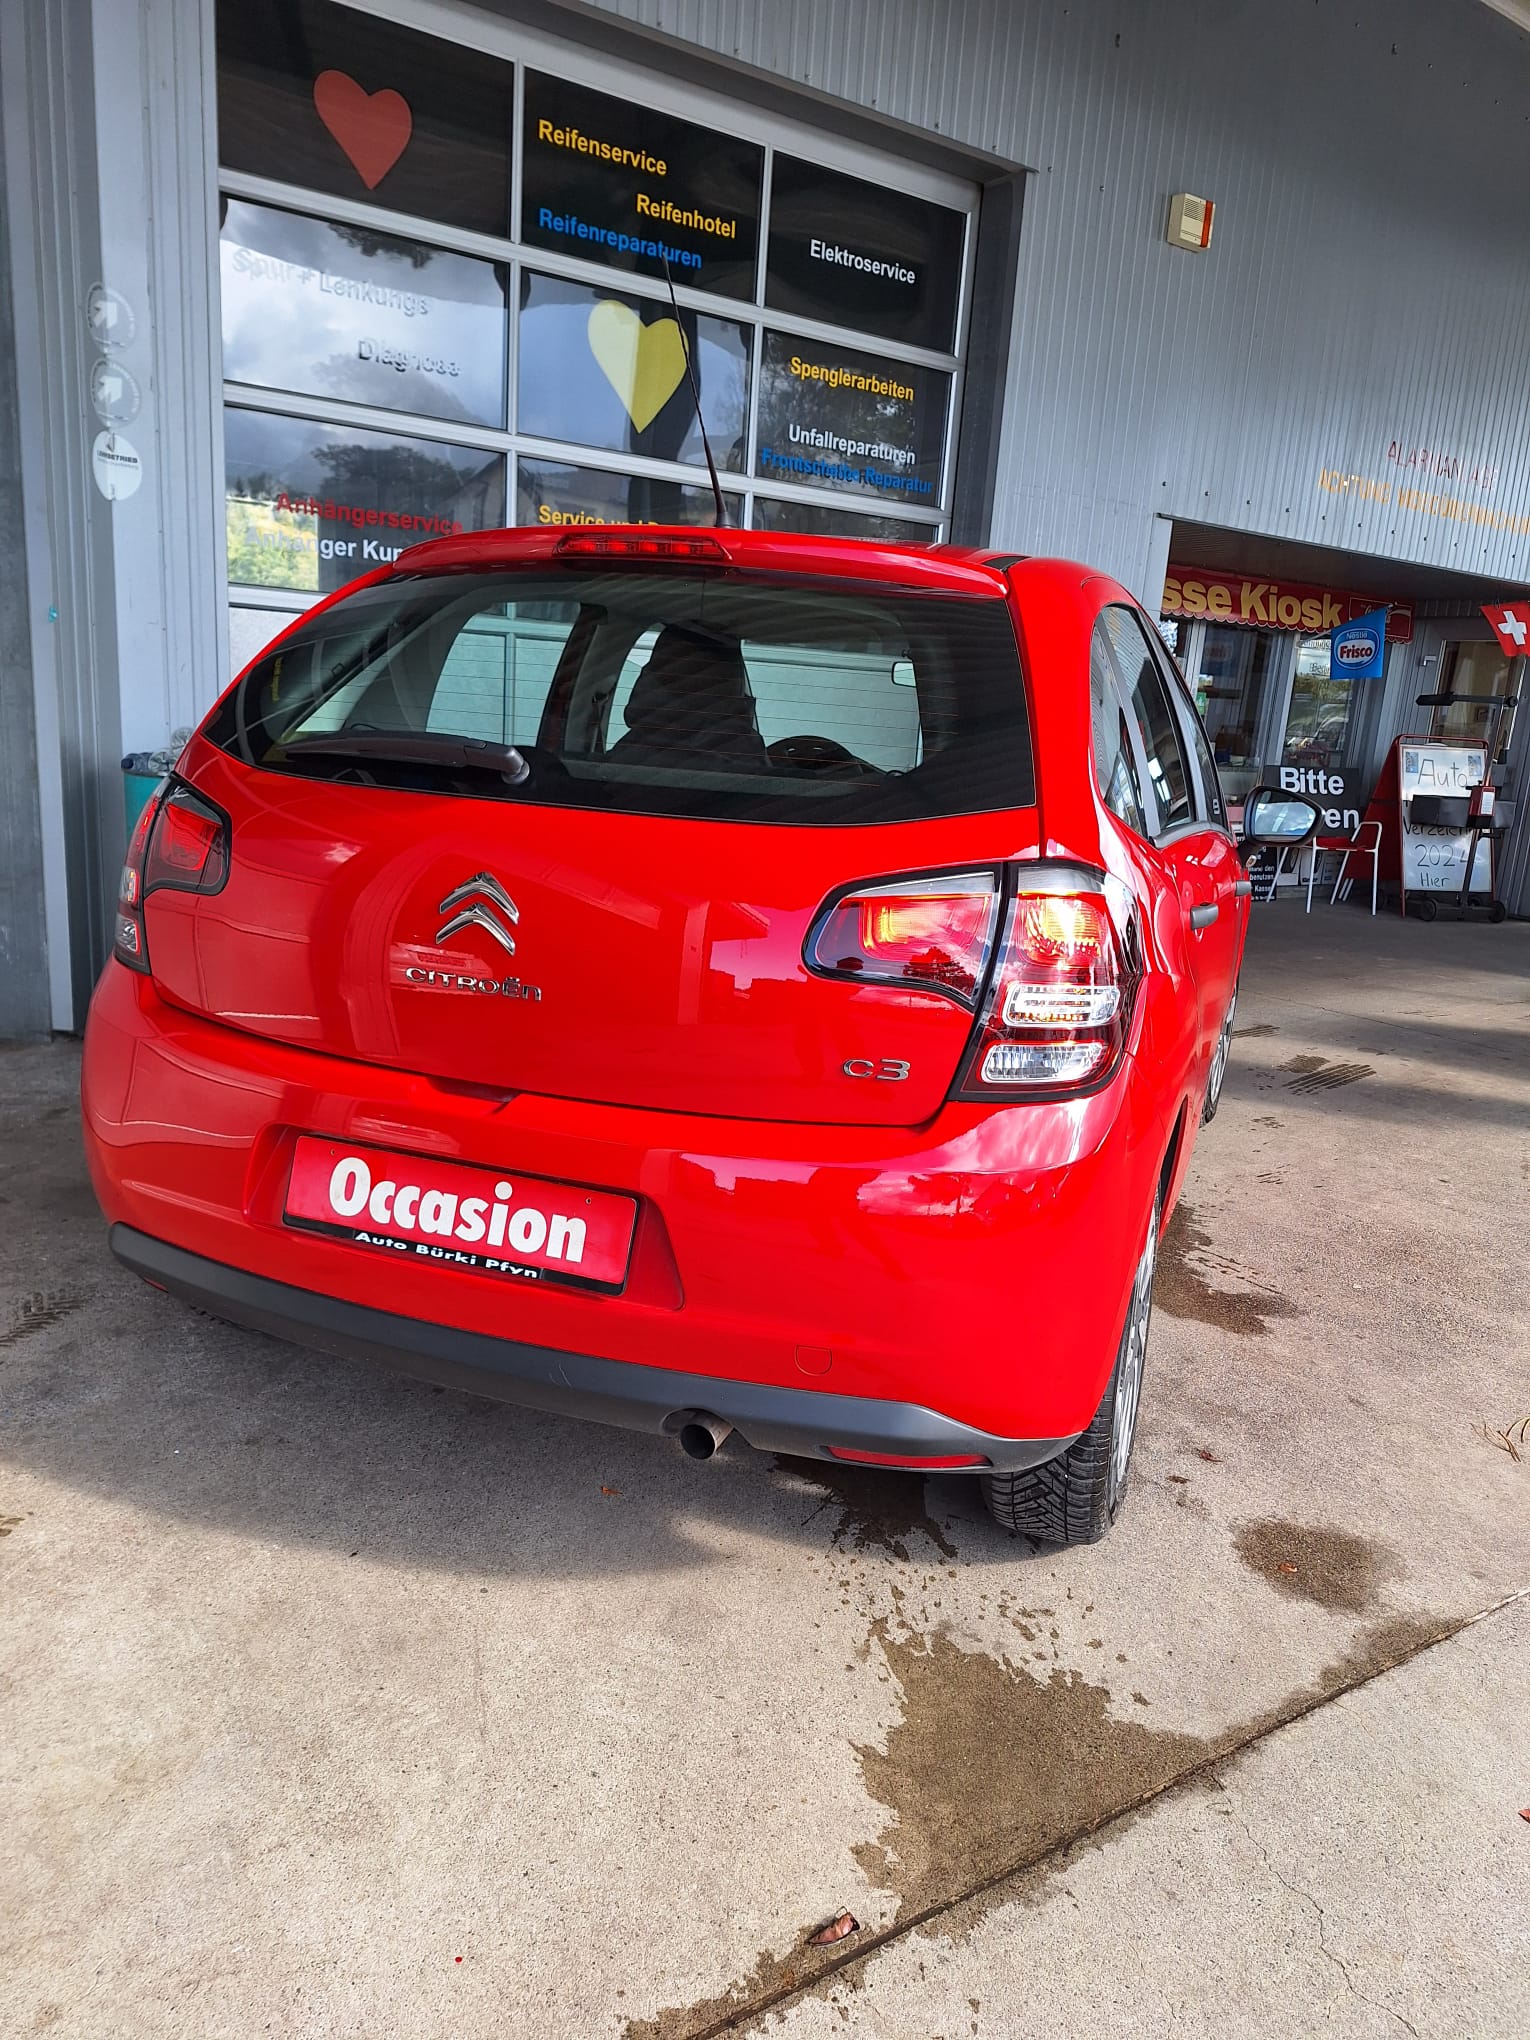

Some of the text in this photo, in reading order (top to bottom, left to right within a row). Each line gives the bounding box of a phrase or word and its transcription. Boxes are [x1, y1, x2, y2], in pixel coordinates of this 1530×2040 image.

[538, 119, 667, 176] Reifenservice
[636, 193, 736, 239] Reifenhotel
[539, 208, 702, 269] Reifenreparaturen
[232, 247, 292, 281] Spur
[319, 271, 429, 317] Lenkungs
[810, 238, 916, 284] Elektroservice
[790, 356, 915, 400] Spenglerarbeiten
[789, 423, 916, 465] Unfallreparaturen
[1318, 467, 1391, 505] ACHTUNG
[276, 492, 464, 535] Anhängerservice
[1162, 578, 1232, 617] sse
[1241, 582, 1344, 629] Kiosk
[1340, 645, 1373, 659] Frisco
[1280, 767, 1345, 795] Bitte
[1417, 758, 1468, 788] Auto
[1324, 807, 1360, 829] en
[1420, 871, 1450, 888] Hier
[842, 1058, 911, 1081] C3
[329, 1156, 587, 1264] Occasion
[355, 1232, 538, 1279] Auto Bürki Pfyn
